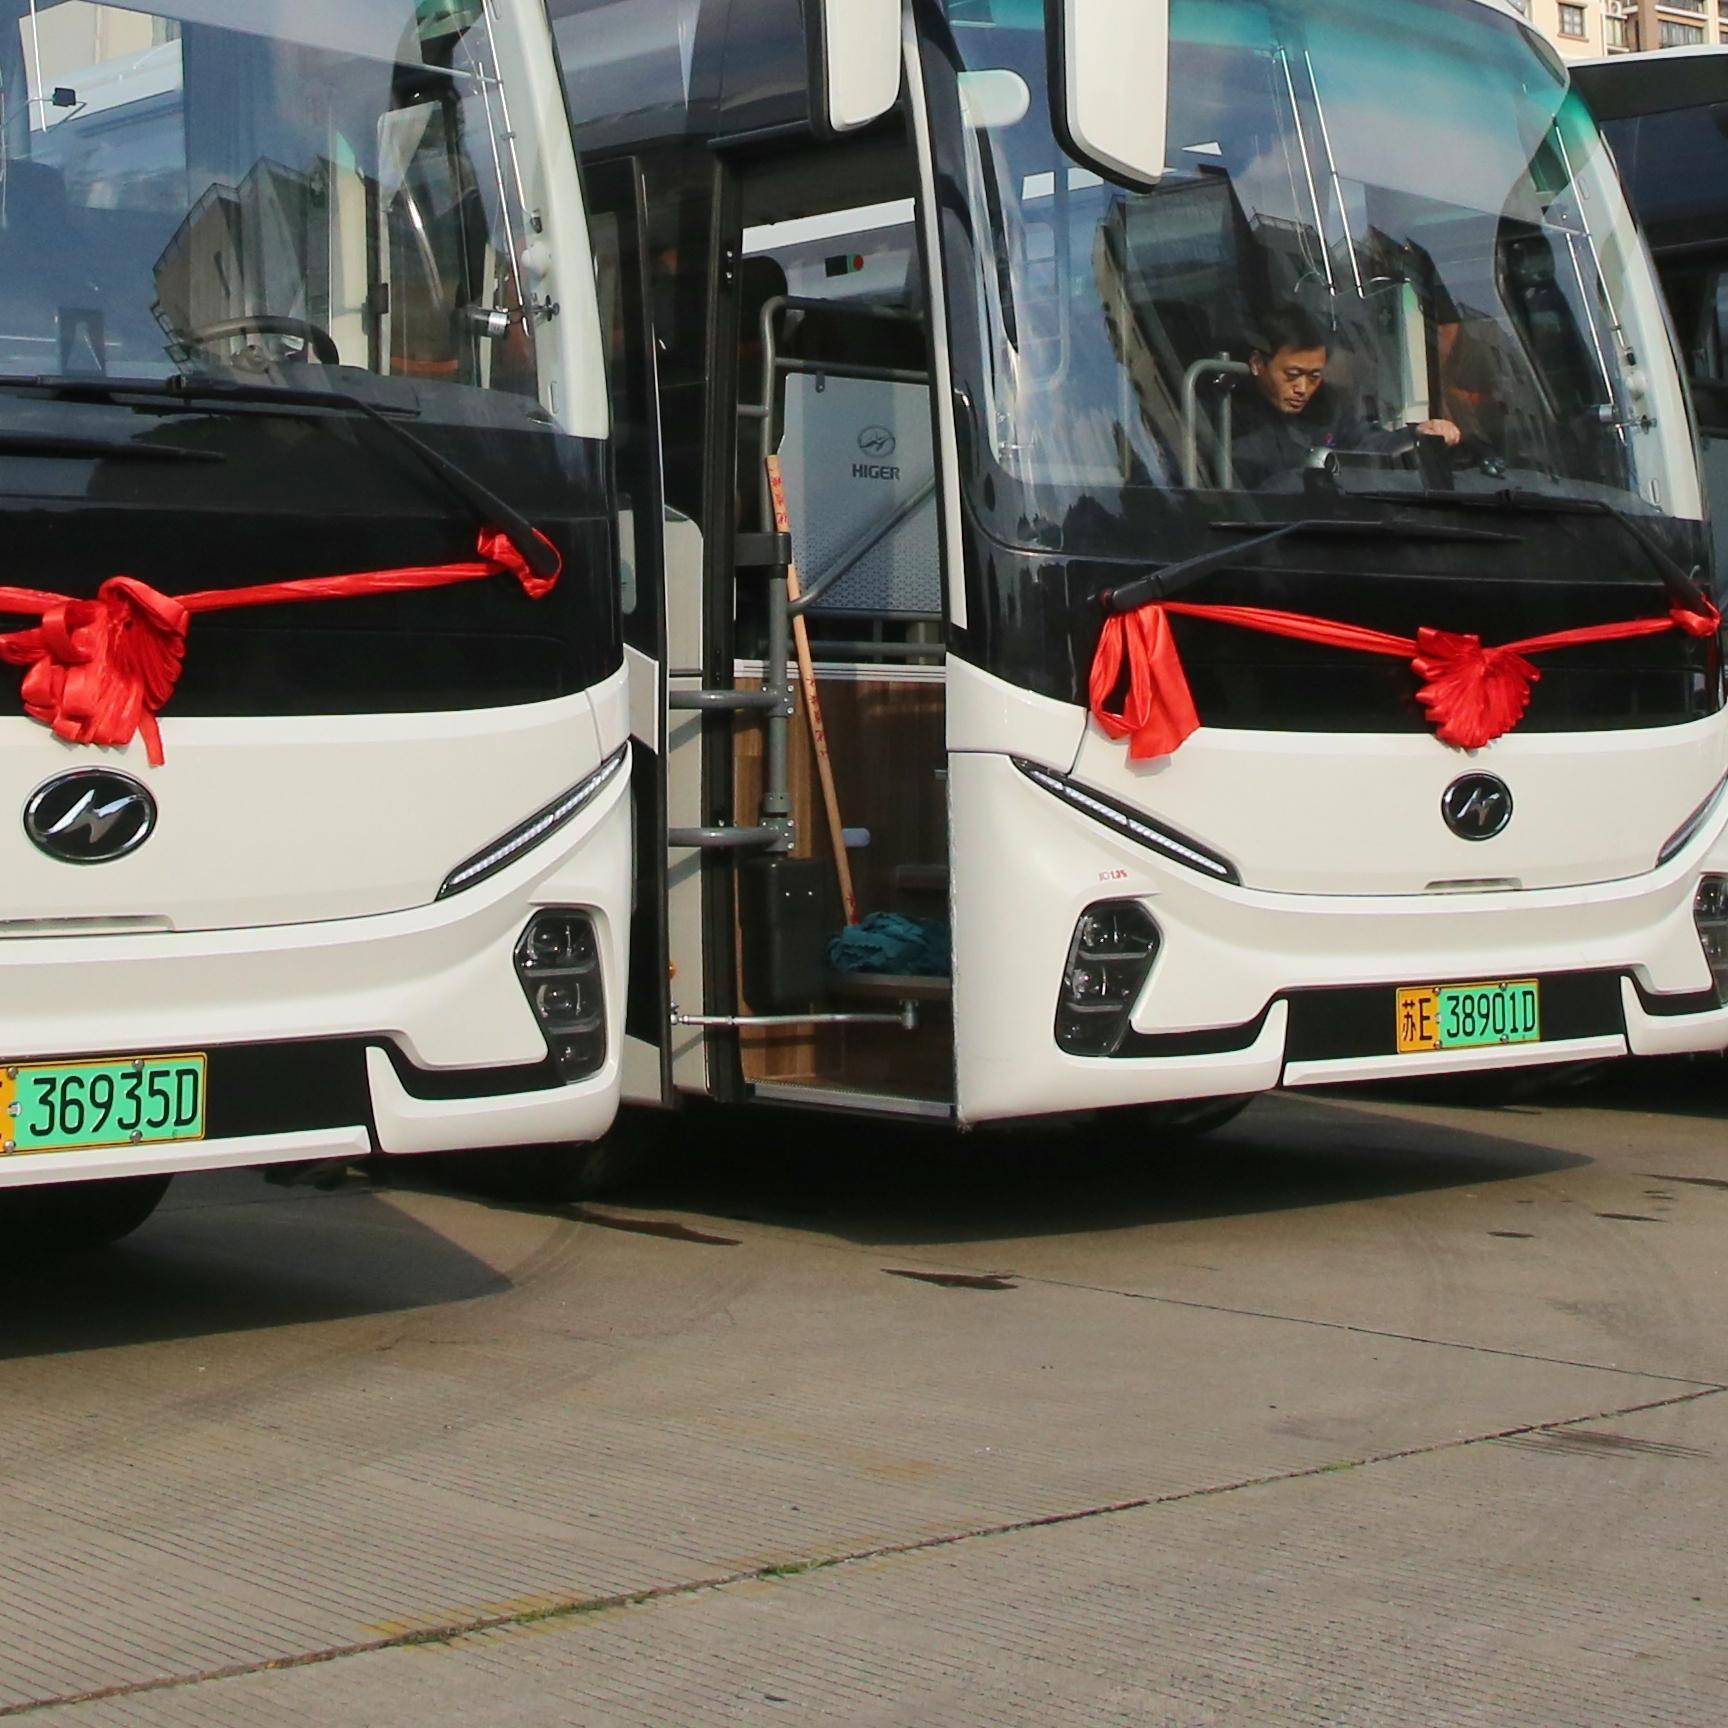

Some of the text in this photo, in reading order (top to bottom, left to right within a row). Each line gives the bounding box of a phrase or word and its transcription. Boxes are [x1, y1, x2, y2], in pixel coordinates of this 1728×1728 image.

[851, 463, 900, 480] HIGER
[1446, 990, 1536, 1039] 38901D
[29, 1068, 200, 1137] 36935D
